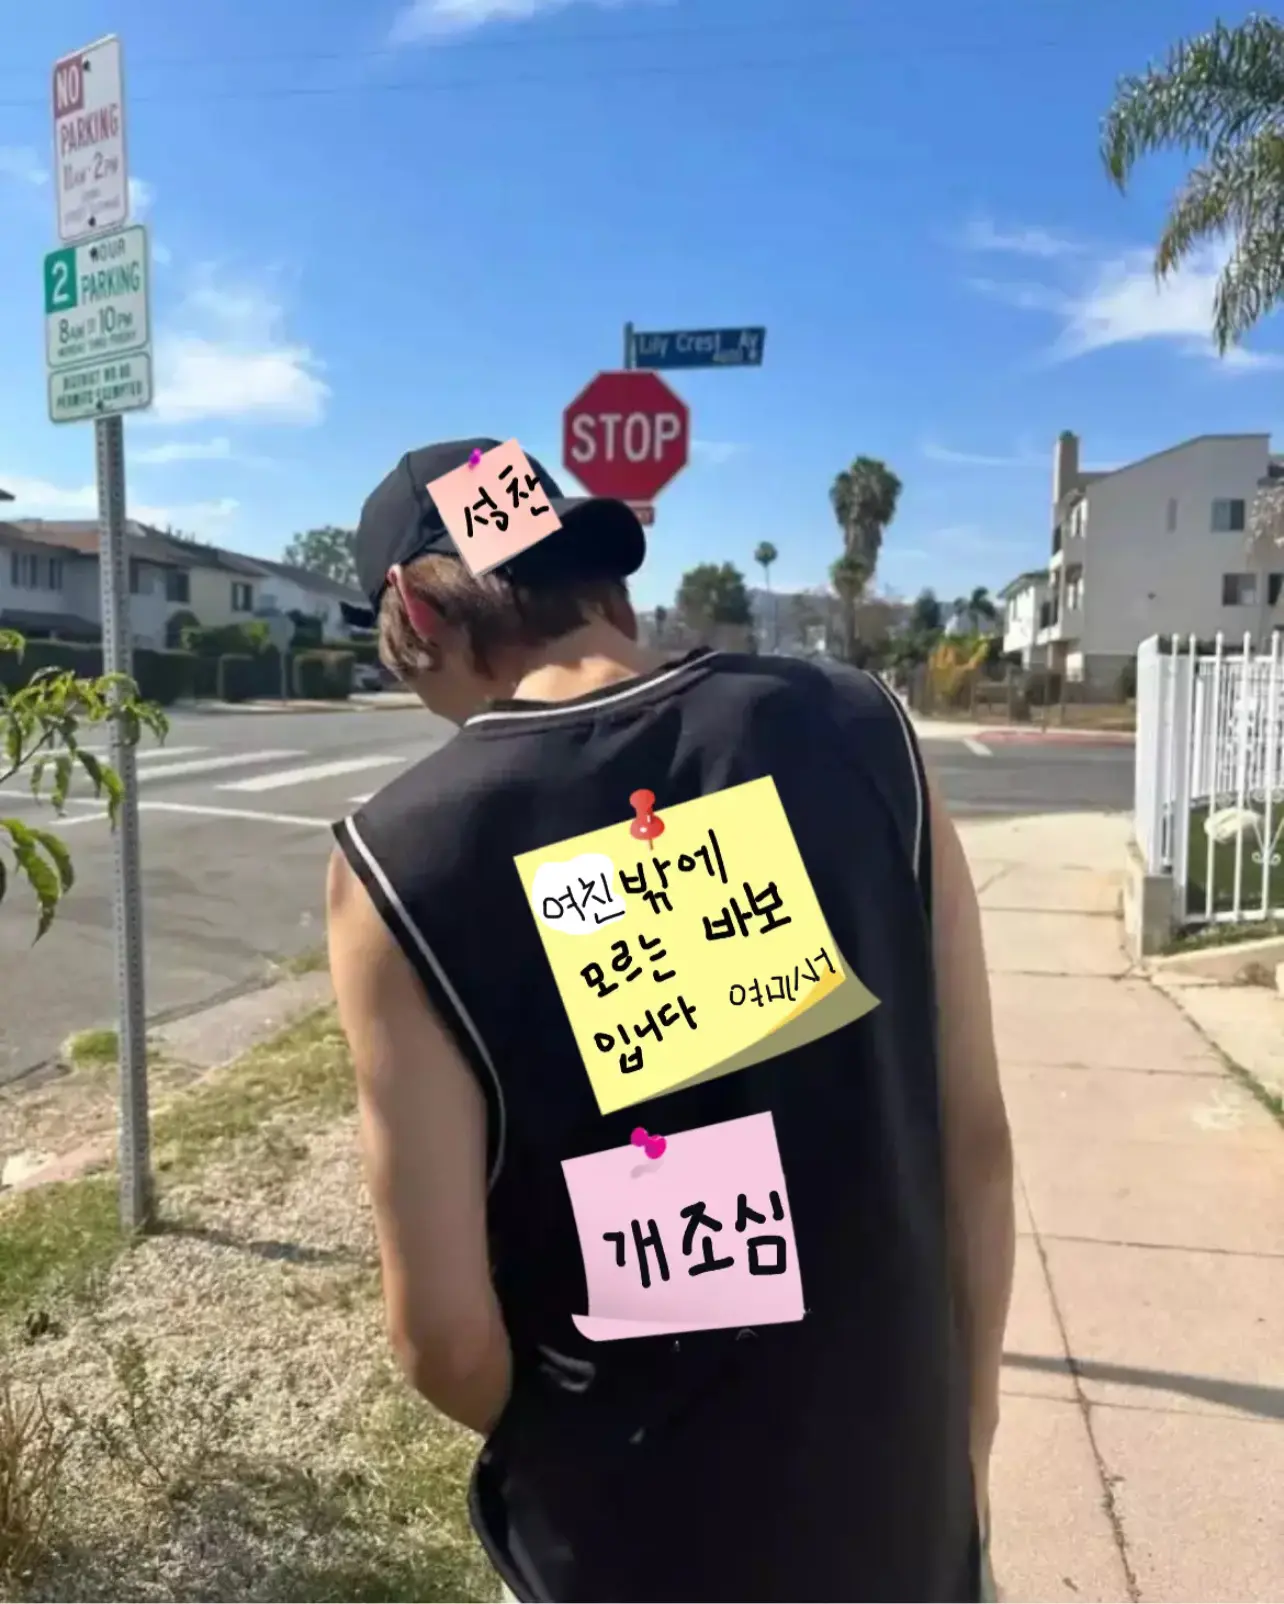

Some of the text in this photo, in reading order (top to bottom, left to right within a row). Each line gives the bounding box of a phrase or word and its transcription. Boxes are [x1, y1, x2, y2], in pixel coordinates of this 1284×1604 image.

[56, 65, 80, 110] NO
[60, 103, 119, 157] PARKING
[51, 260, 71, 304] 2
[80, 261, 140, 305] PARKING
[640, 335, 669, 359] Lily
[676, 331, 721, 352] Crest
[570, 411, 682, 463] STOP
